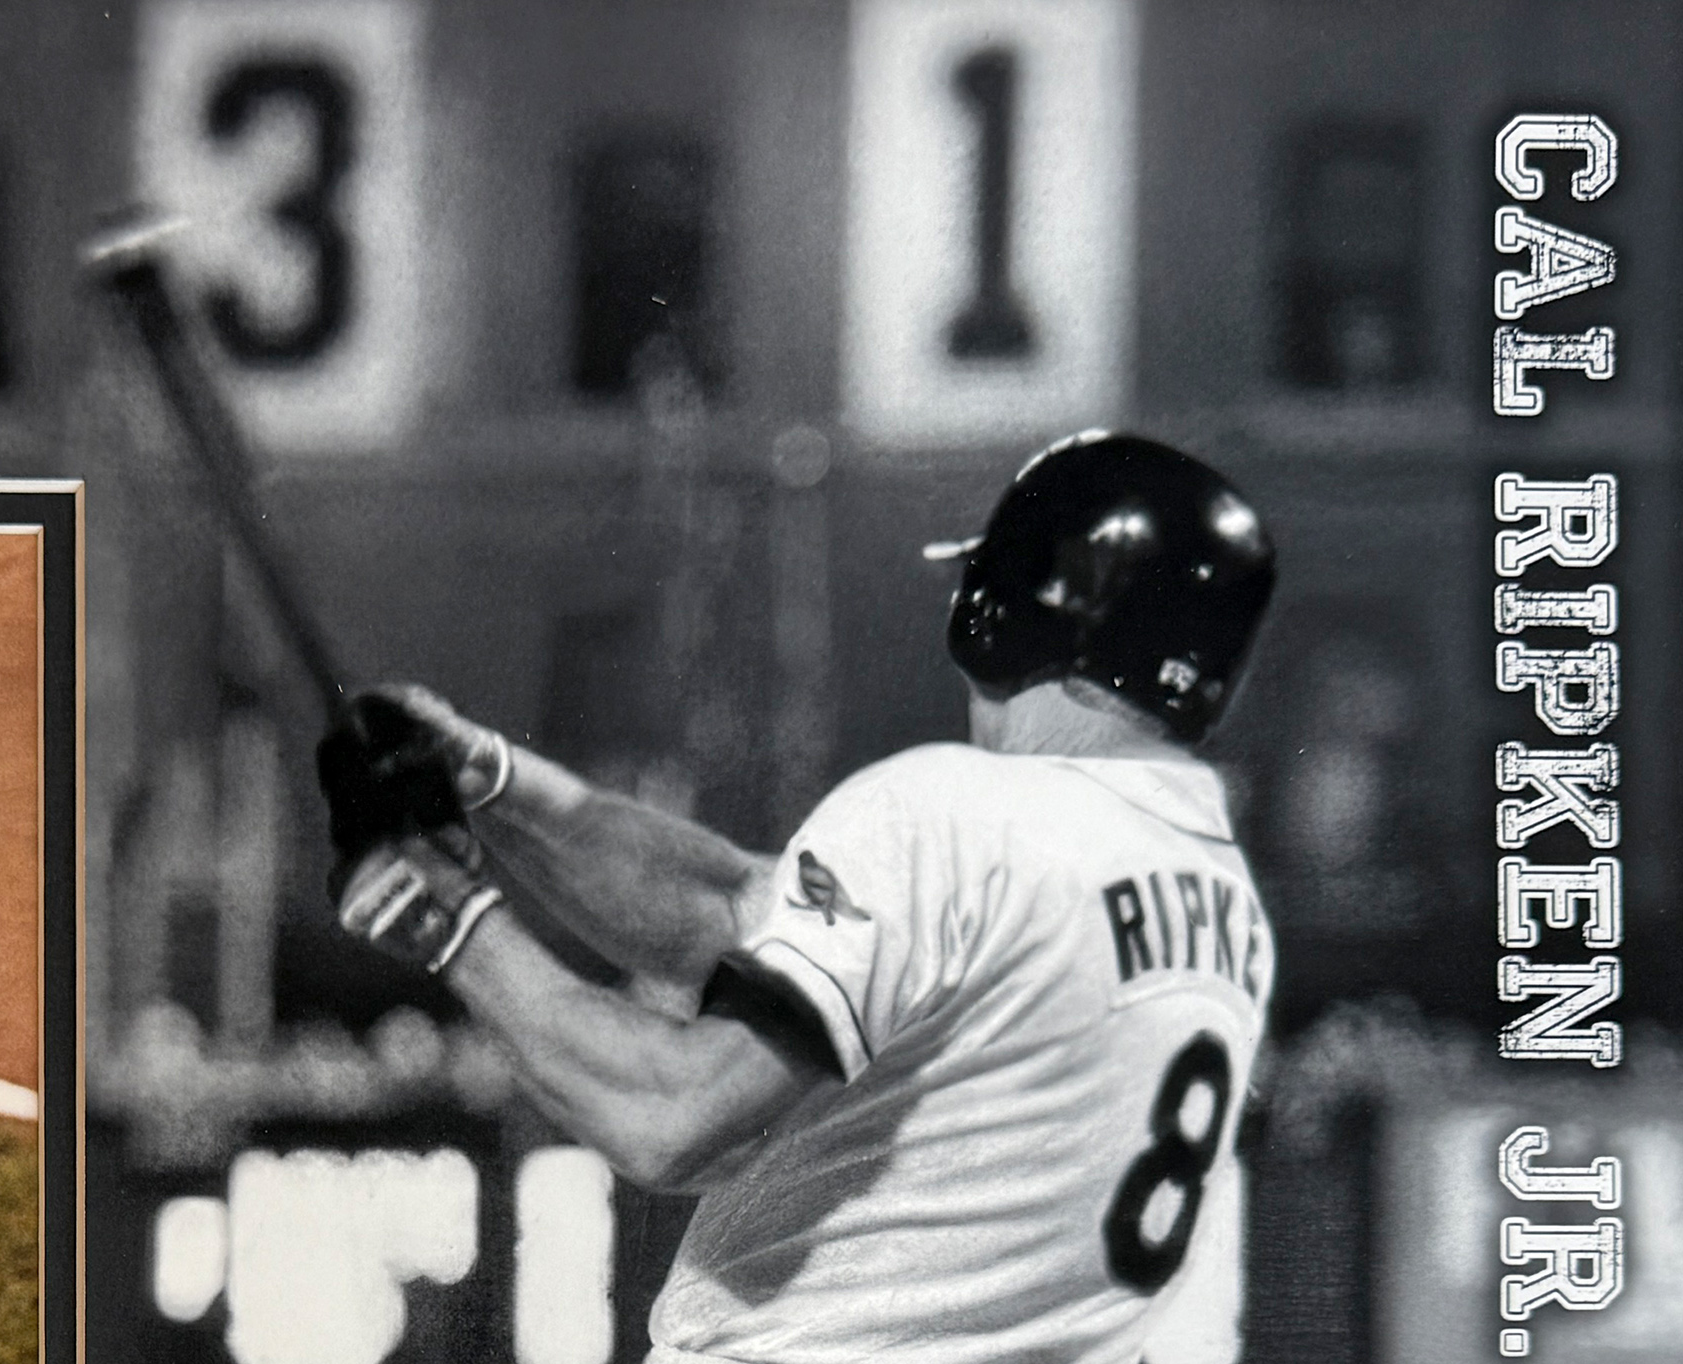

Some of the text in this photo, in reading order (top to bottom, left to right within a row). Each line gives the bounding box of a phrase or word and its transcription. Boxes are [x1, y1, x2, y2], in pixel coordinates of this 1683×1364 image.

[202, 53, 356, 369] 3
[946, 46, 1036, 360] 1
[1492, 112, 1621, 417] CAL
[1493, 472, 1624, 1068] RIPKEN
[1101, 1028, 1232, 1297] 8
[1497, 1125, 1627, 1358] JR.
